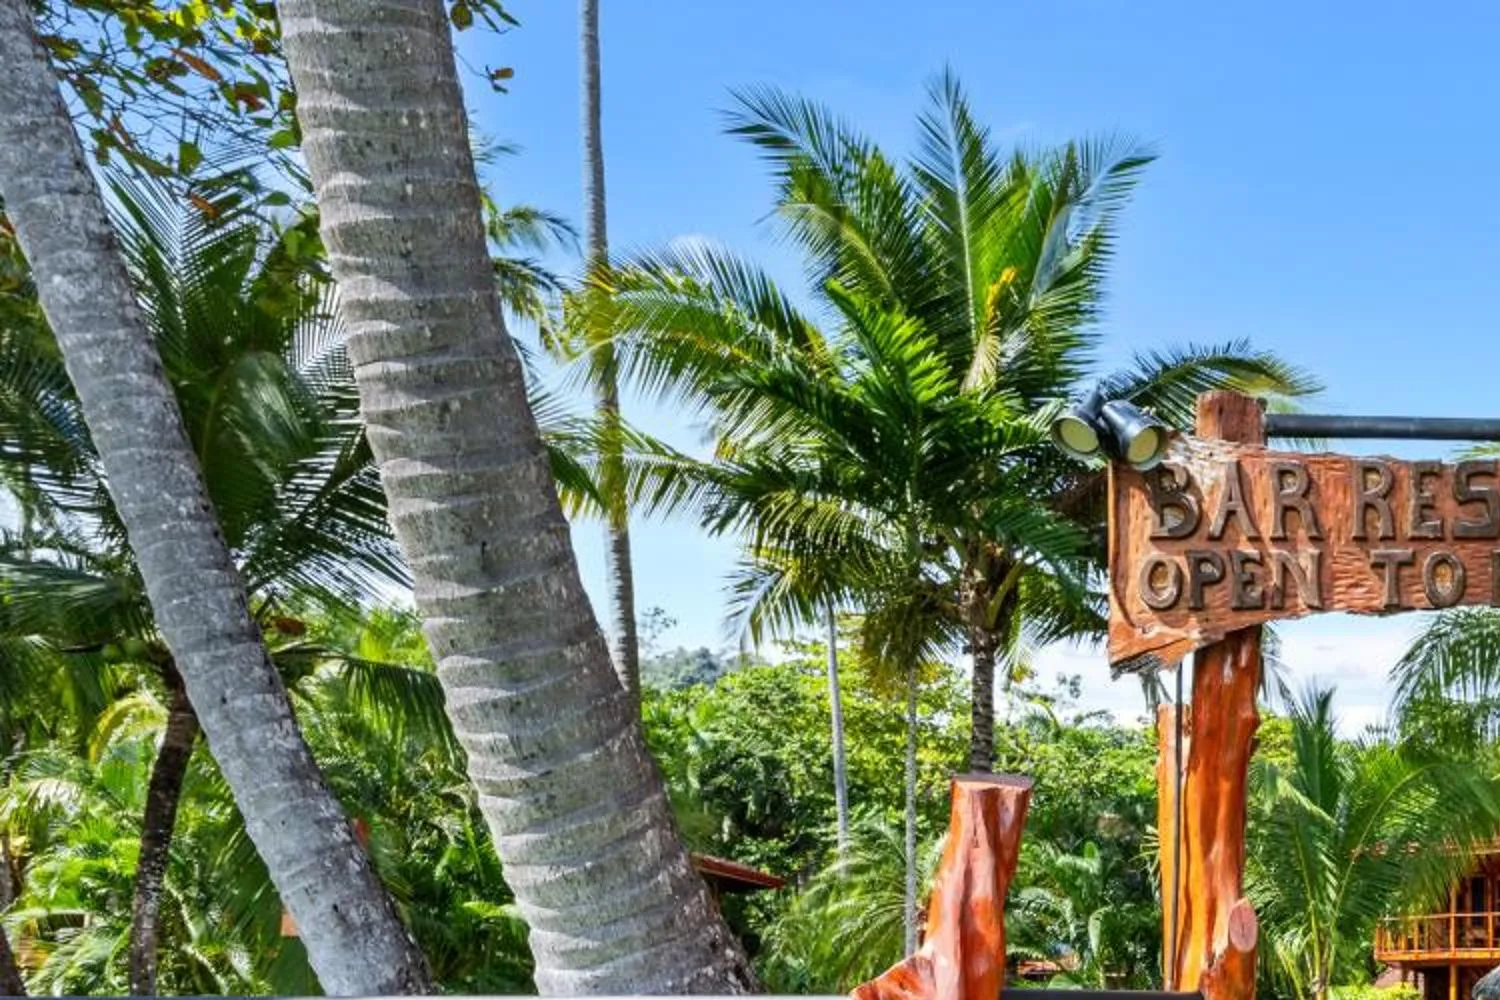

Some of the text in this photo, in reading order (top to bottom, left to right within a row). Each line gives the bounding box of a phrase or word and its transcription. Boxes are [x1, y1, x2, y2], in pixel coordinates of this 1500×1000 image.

[1150, 459, 1324, 540] BAR
[1139, 548, 1323, 611] OPEN
[1372, 549, 1466, 608] TO
